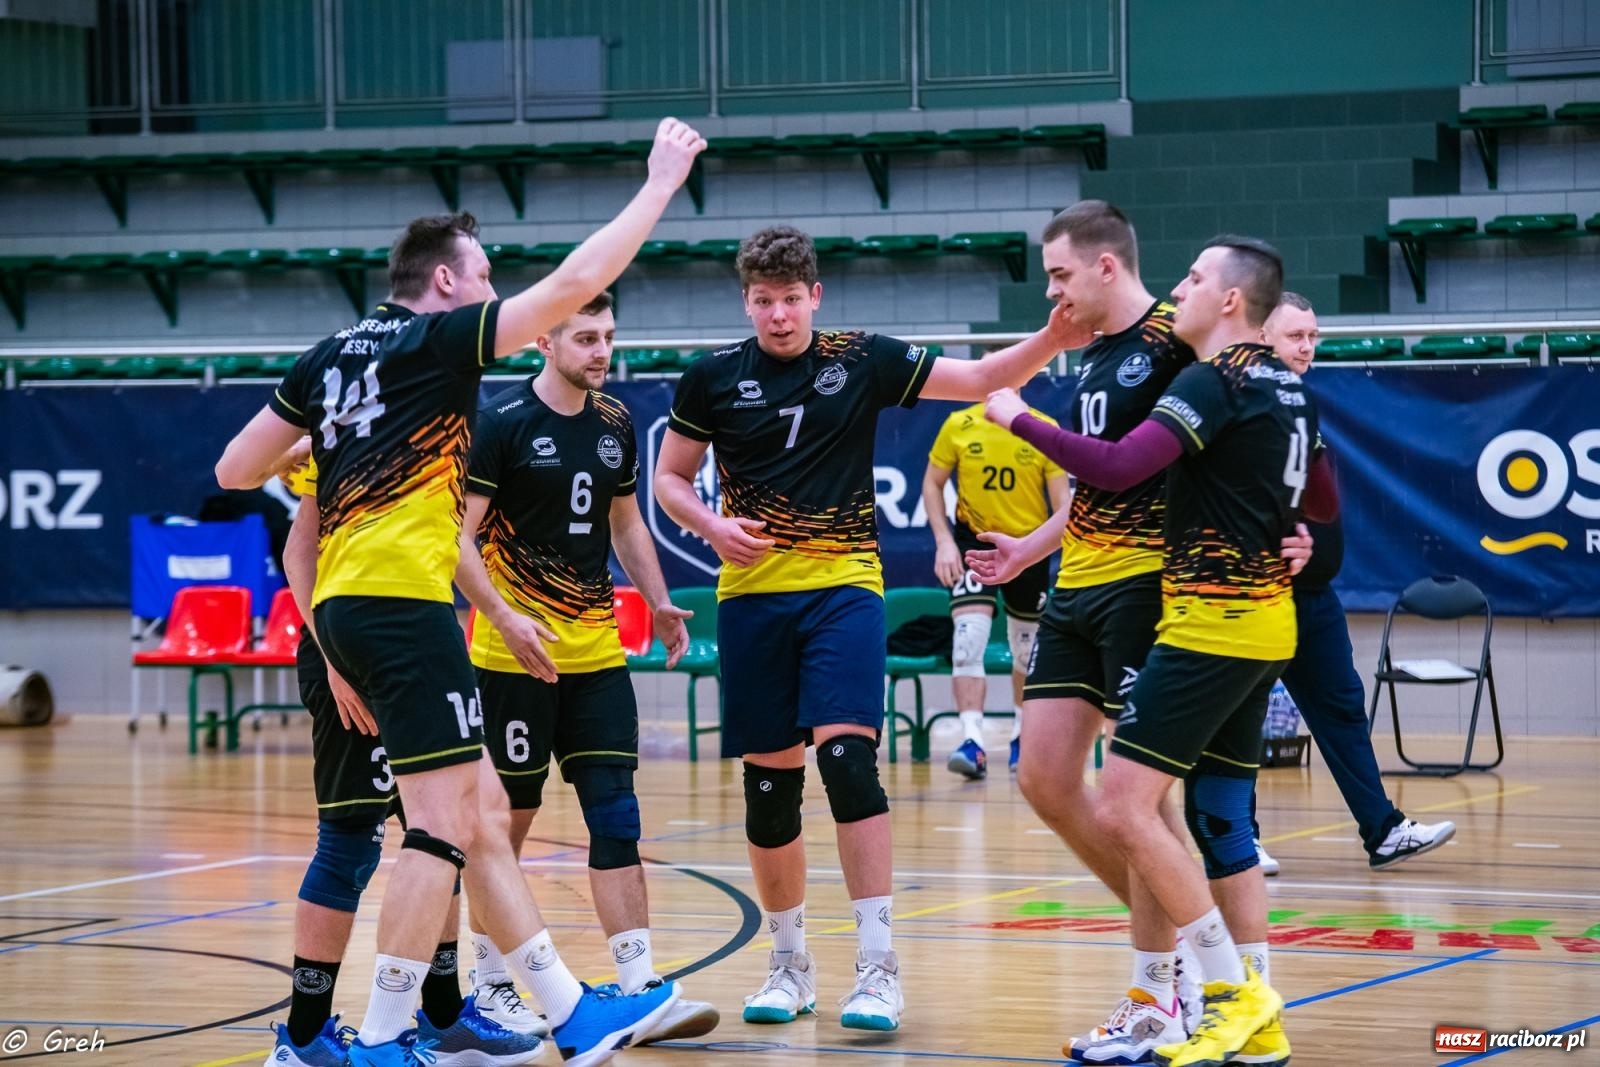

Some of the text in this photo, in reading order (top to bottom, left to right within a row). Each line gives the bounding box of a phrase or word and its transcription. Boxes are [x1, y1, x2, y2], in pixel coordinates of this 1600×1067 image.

[320, 361, 386, 450] 14
[778, 404, 804, 448] 7
[1080, 391, 1108, 436] 10
[982, 466, 1016, 492] 20
[1283, 417, 1309, 508] 4
[0, 469, 103, 530] RZ
[570, 471, 593, 516] 6
[446, 687, 485, 739] 14
[505, 720, 530, 764] 6
